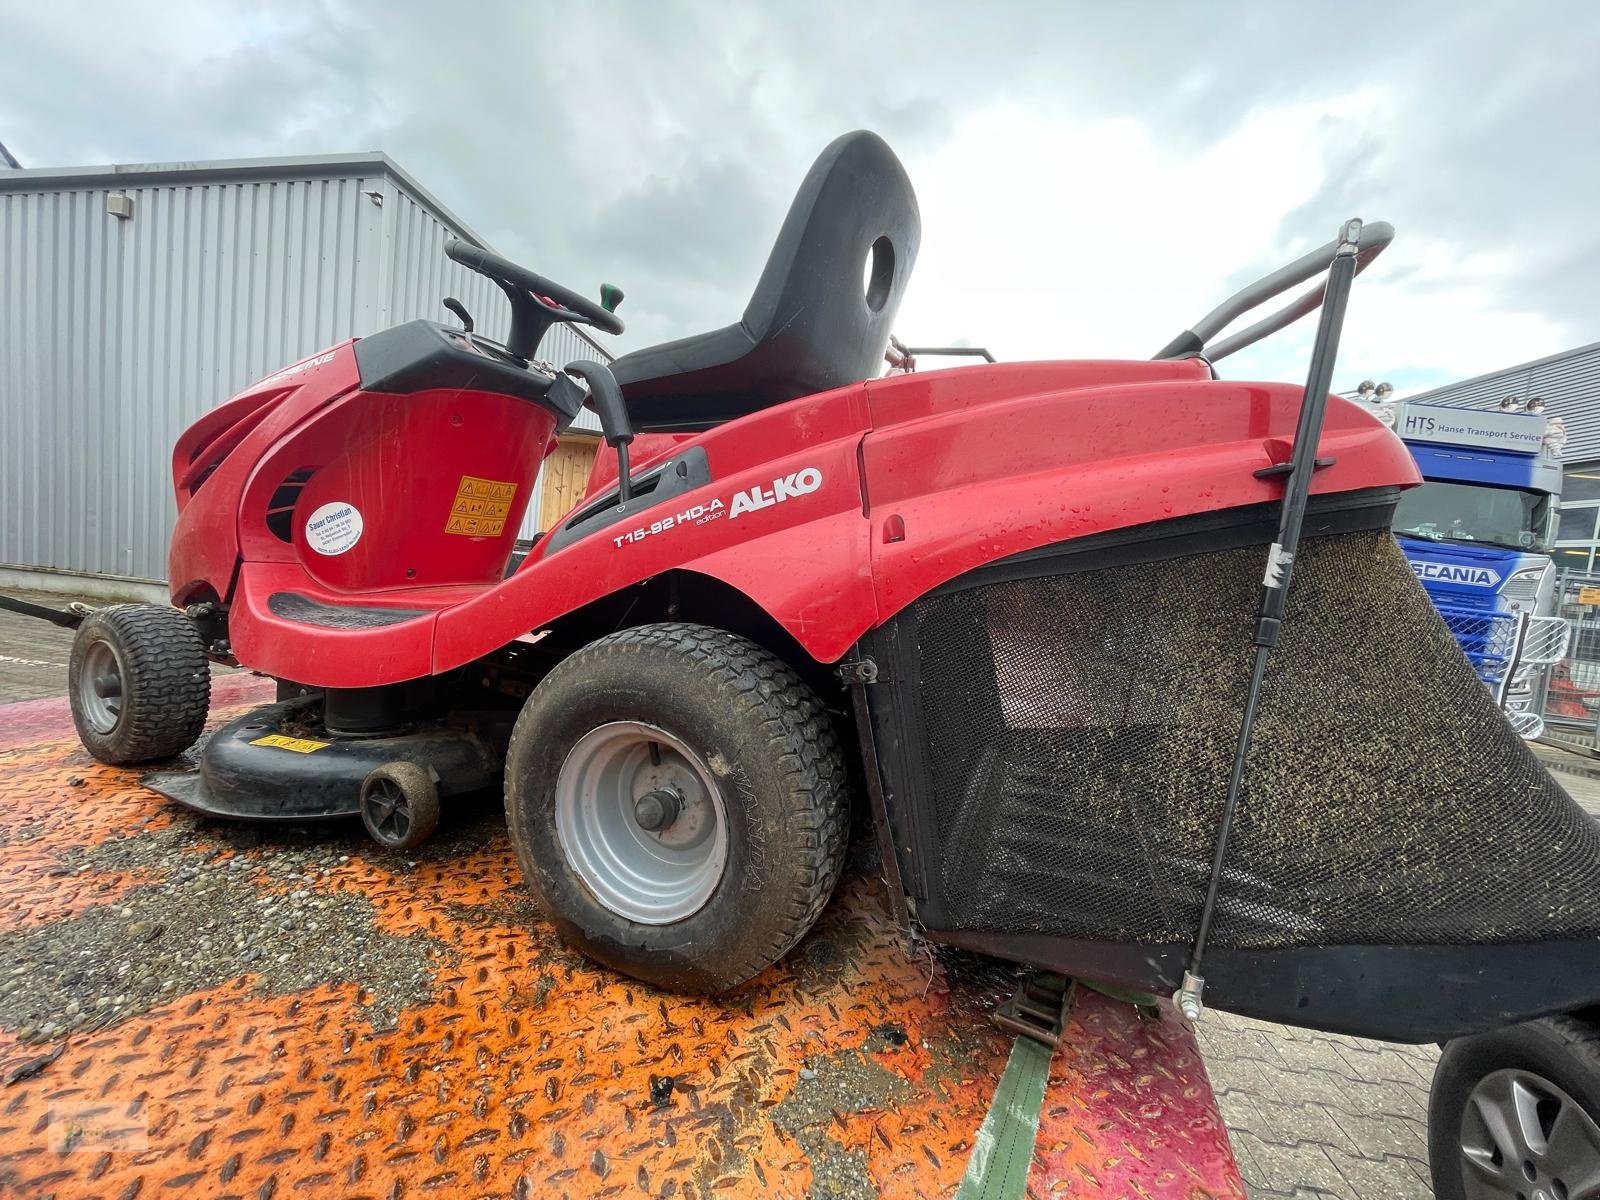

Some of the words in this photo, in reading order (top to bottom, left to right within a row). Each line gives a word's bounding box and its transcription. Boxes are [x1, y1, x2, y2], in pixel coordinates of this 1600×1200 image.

[1405, 415, 1435, 430] HTS
[1438, 425, 1464, 434] Hanse
[1467, 427, 1508, 439] Transport
[1509, 431, 1542, 442] Service
[728, 467, 823, 520] AL-KO
[308, 519, 326, 532] Sauer
[325, 507, 352, 524] Christian
[613, 515, 675, 548] T15-92
[676, 498, 725, 525] HD-A
[695, 509, 727, 526] edition
[1410, 563, 1491, 585] SCANIA
